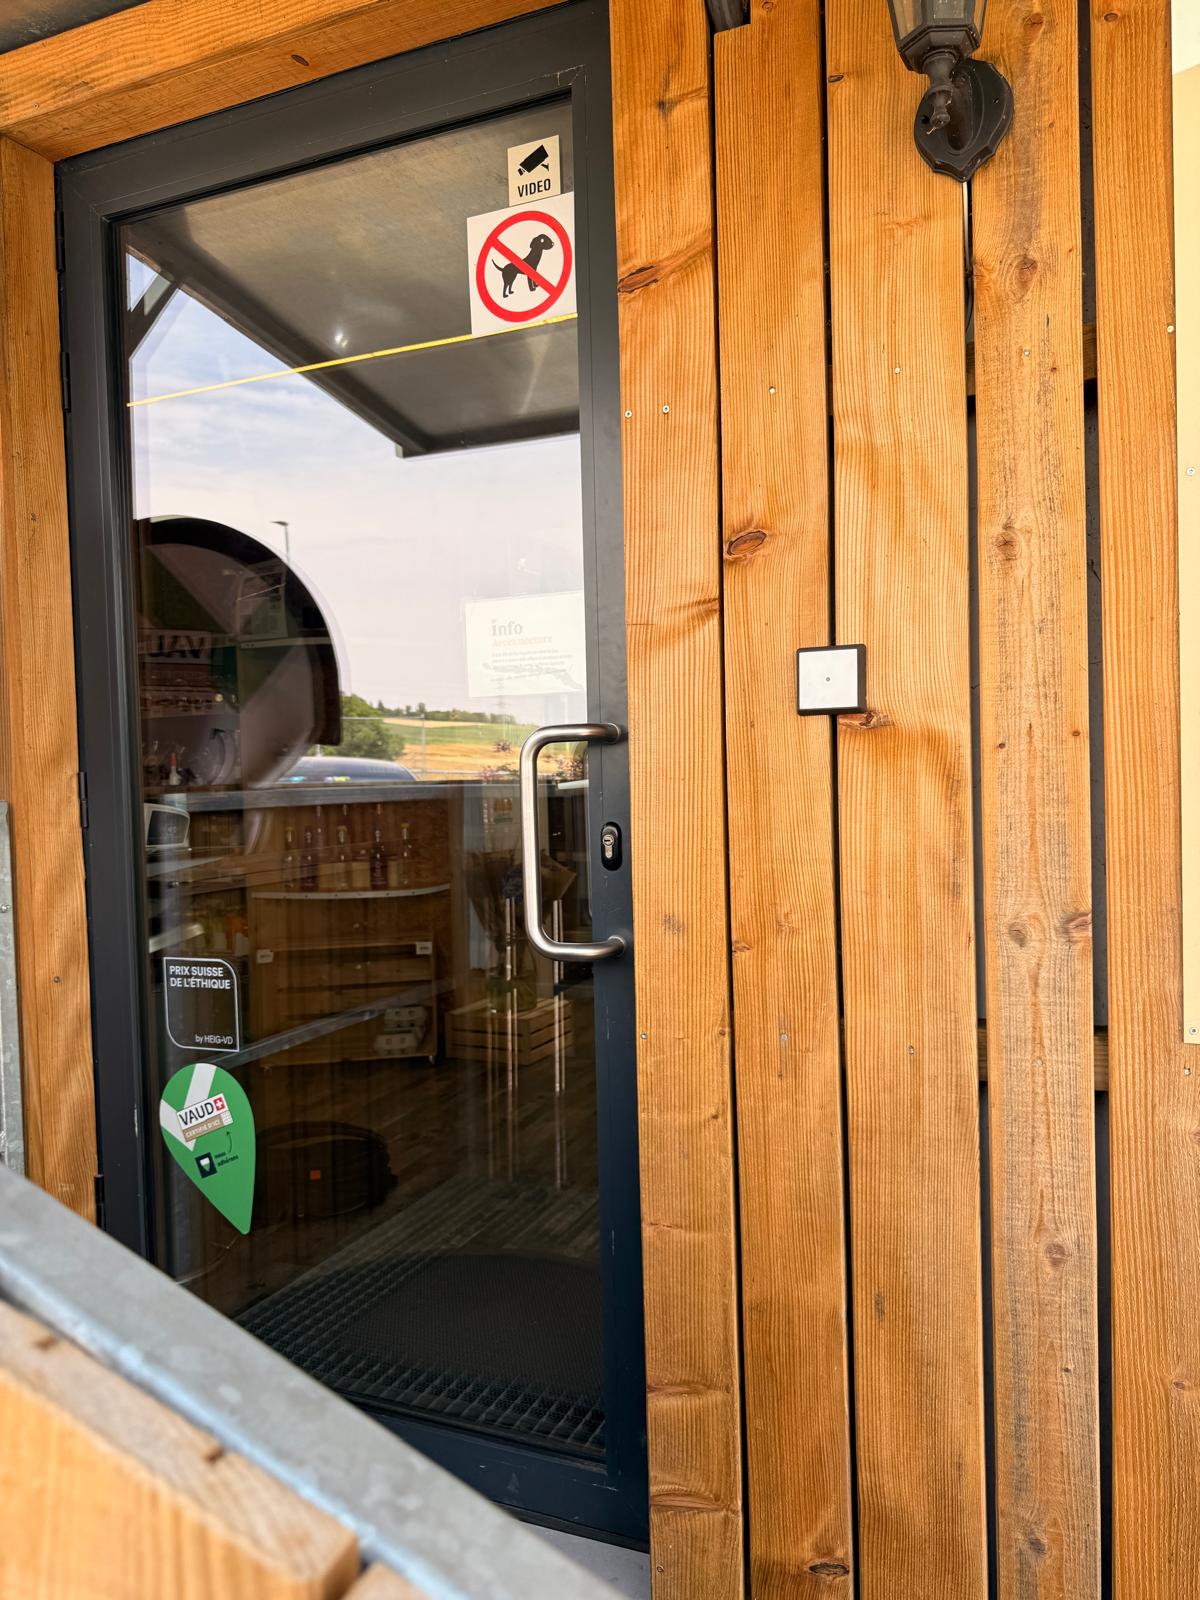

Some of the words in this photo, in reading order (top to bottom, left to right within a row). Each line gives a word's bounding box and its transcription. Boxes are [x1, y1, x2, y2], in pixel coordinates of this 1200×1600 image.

[517, 178, 551, 197] VIDEO
[491, 619, 523, 636] info
[169, 965, 190, 975] PRIX
[191, 966, 224, 977] SUISSE
[170, 978, 182, 987] DE
[184, 976, 231, 989] L'ÉTHIQUE
[195, 1035, 203, 1044] by
[204, 1035, 233, 1045] HEIG-VD
[179, 1102, 214, 1125] VAUD
